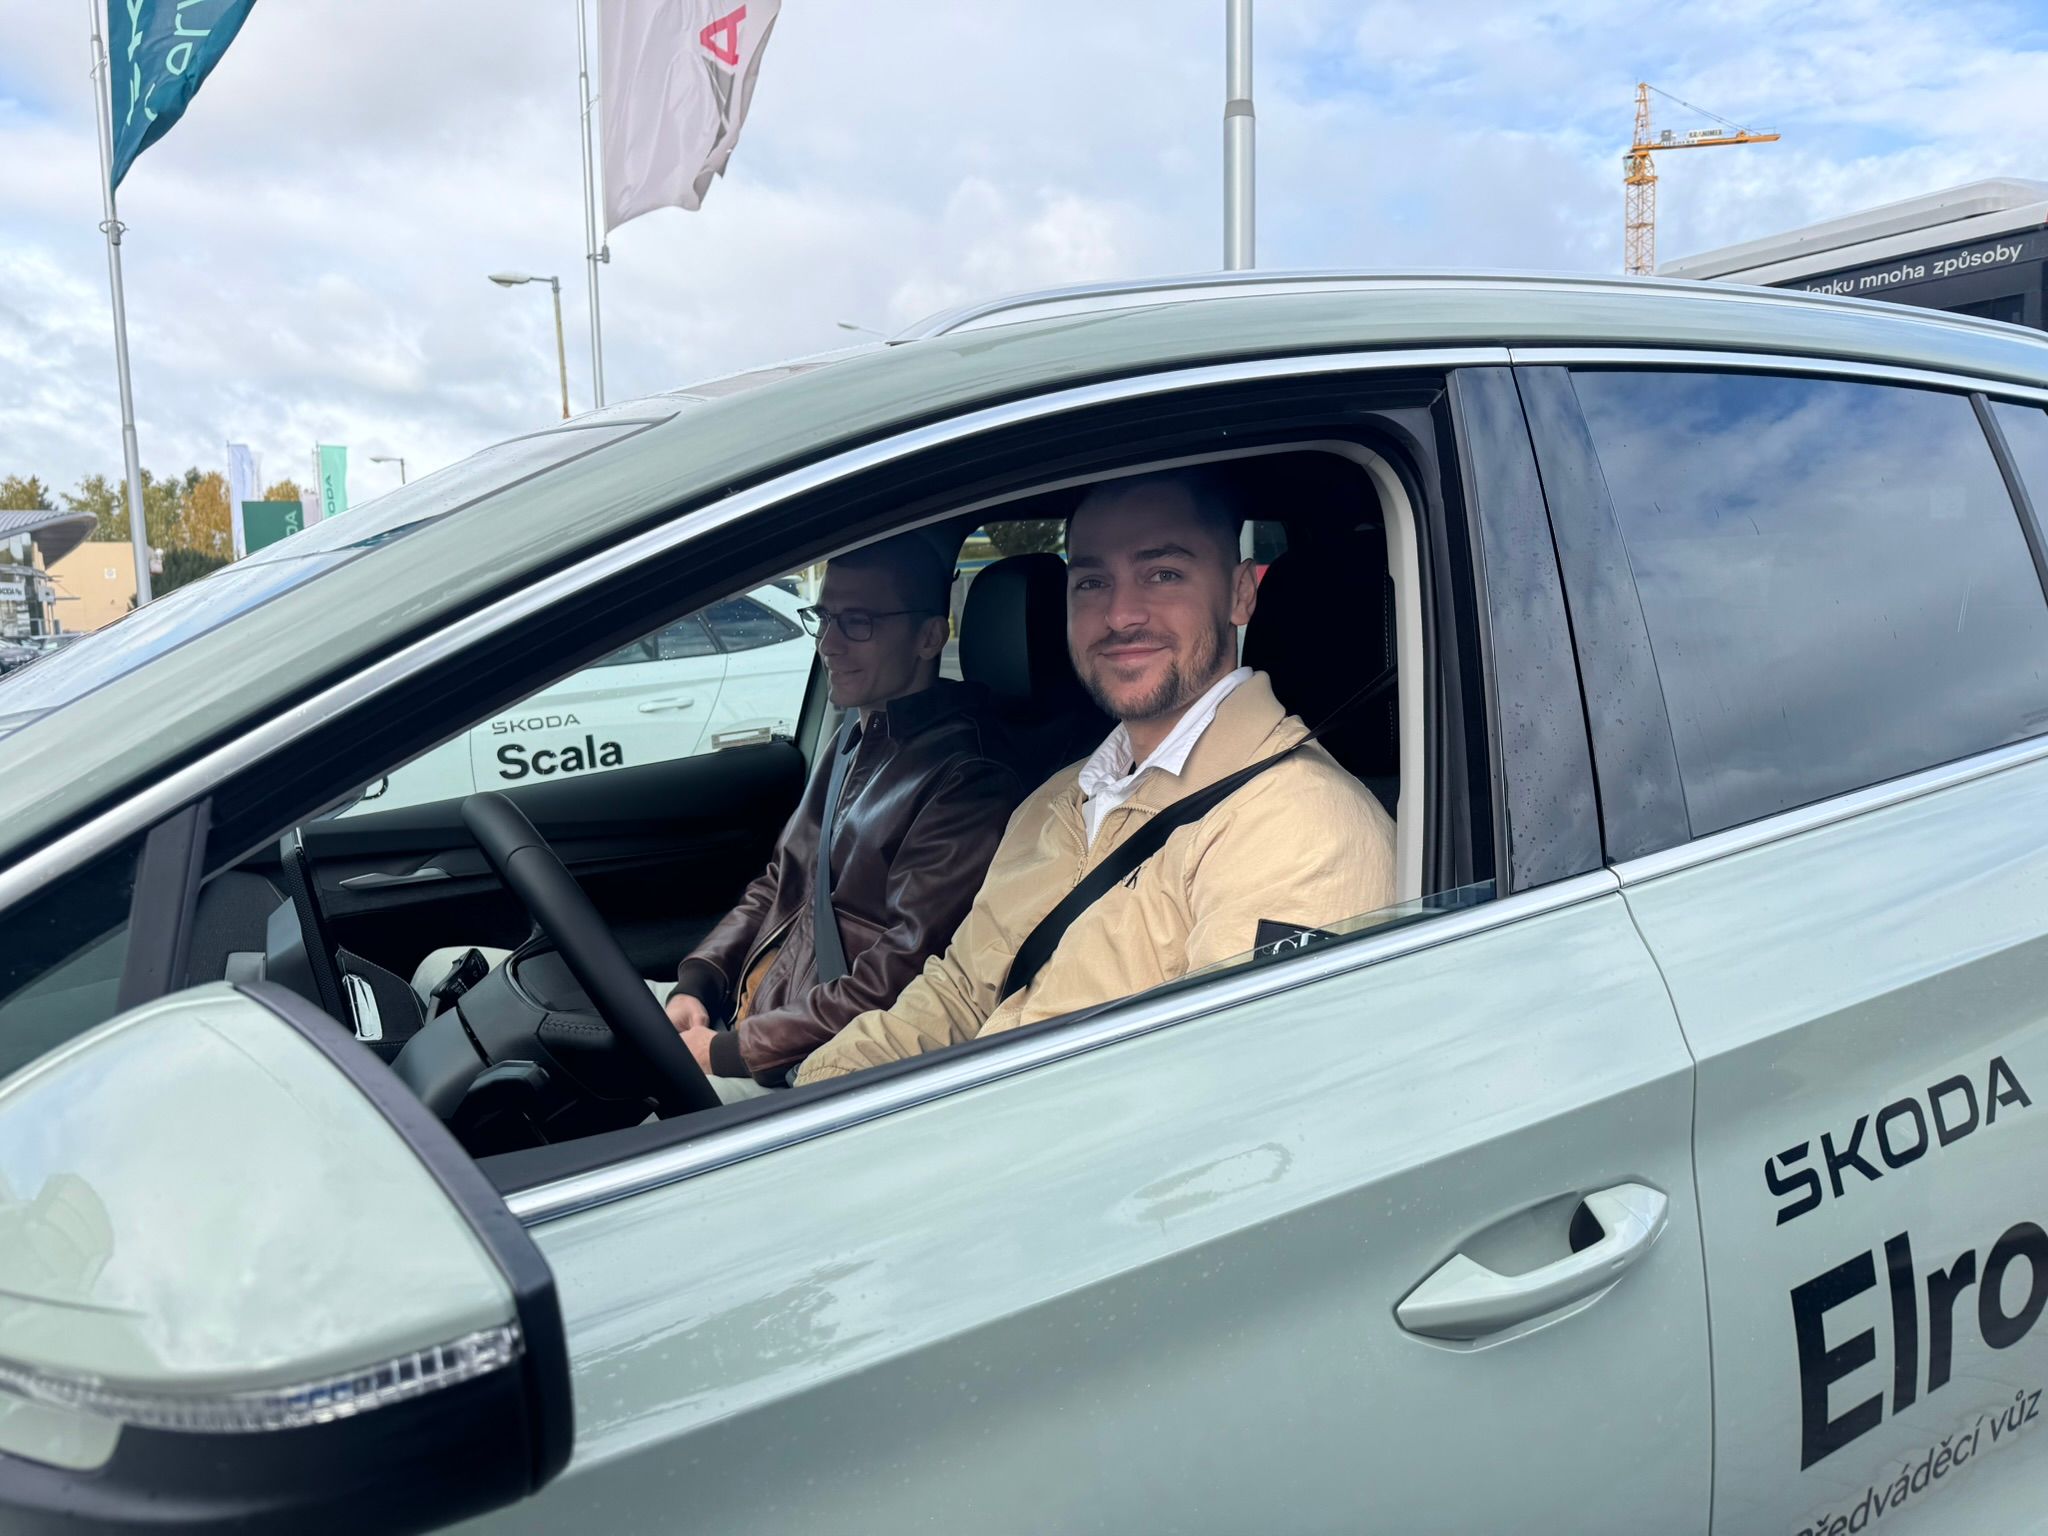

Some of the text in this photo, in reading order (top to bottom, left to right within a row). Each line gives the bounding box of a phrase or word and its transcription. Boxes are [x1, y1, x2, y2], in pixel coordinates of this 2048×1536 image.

[1859, 264, 1925, 289] mnoha
[1932, 244, 2023, 276] způsoby
[497, 734, 623, 780] Scala
[1790, 1221, 2048, 1472] Elro
[1990, 1389, 2043, 1444] vůz
